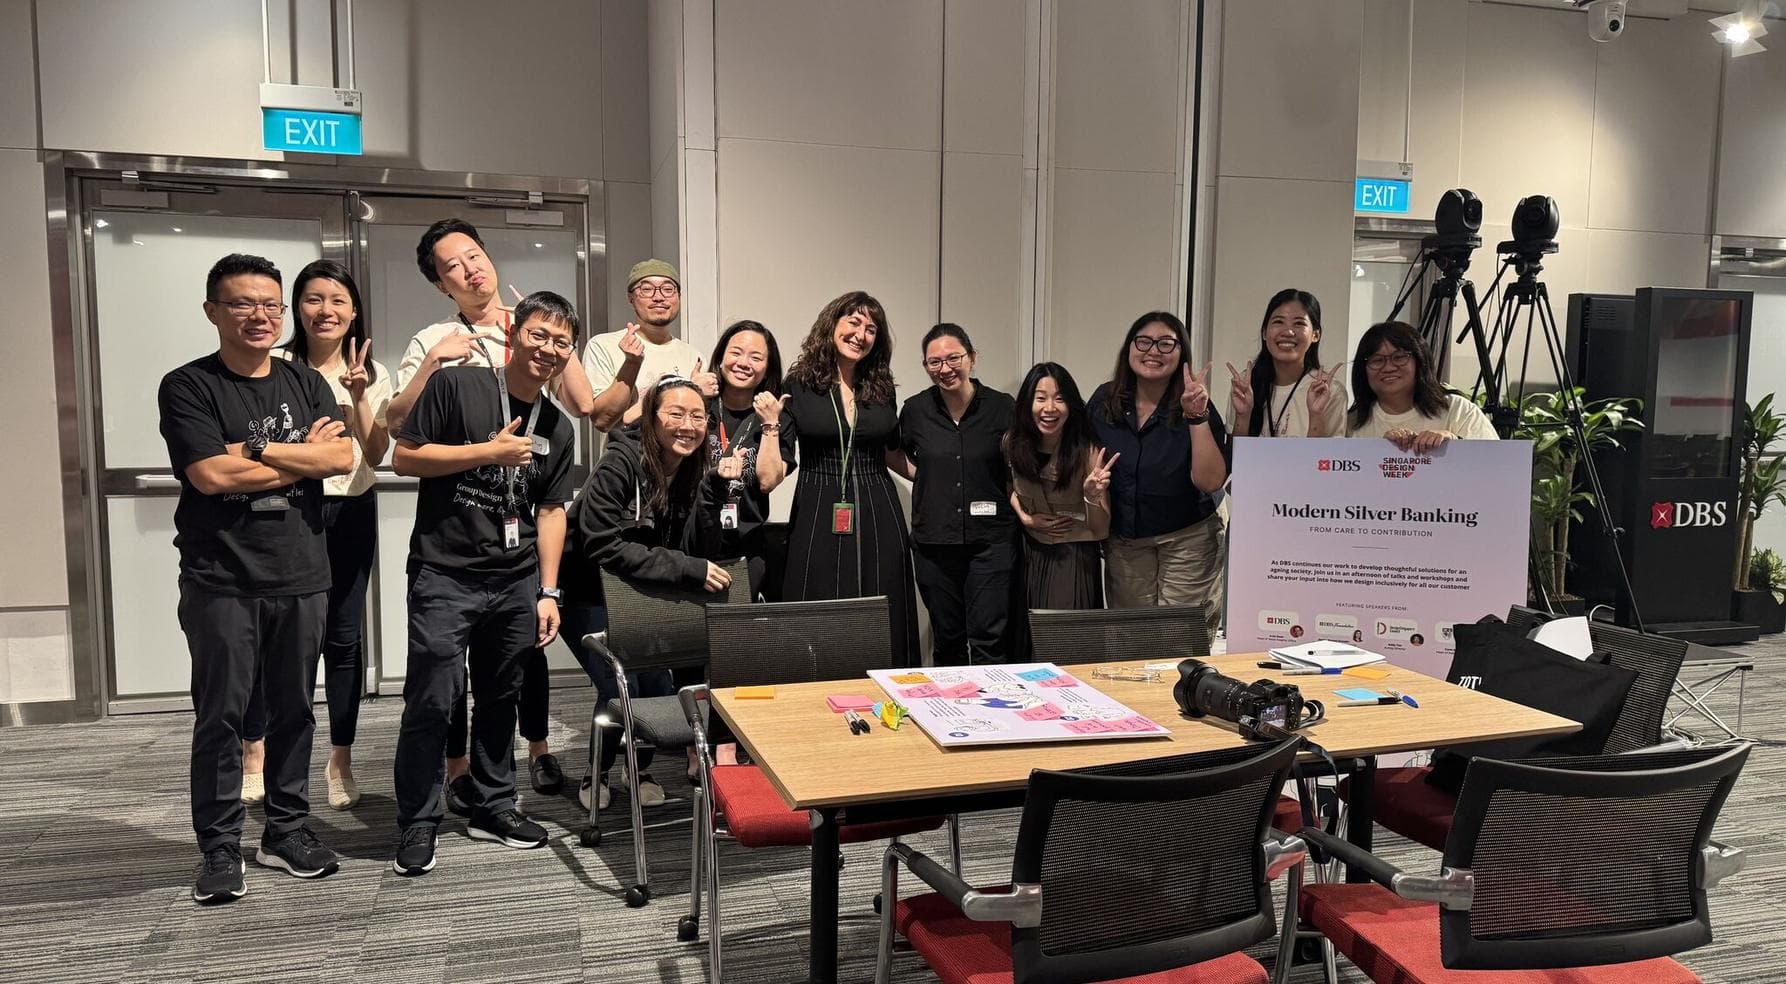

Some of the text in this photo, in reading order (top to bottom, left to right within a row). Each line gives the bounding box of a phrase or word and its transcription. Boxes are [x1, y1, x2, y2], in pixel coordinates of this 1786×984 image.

[285, 117, 340, 147] EXIT
[1362, 184, 1397, 207] EXIT
[1383, 457, 1432, 465] SINGAPORE
[1332, 459, 1361, 472] DBS
[1382, 464, 1415, 472] DESIGN
[1383, 471, 1409, 479] WEEK
[456, 482, 503, 503] Group Design
[1272, 503, 1479, 527] Modern Silver Banking
[1673, 501, 1727, 527] DBS
[1371, 529, 1433, 537] CONTRIBUTION
[1384, 565, 1417, 573] thoughtful
[1375, 580, 1408, 588] inclusively
[1274, 617, 1291, 625] DBS
